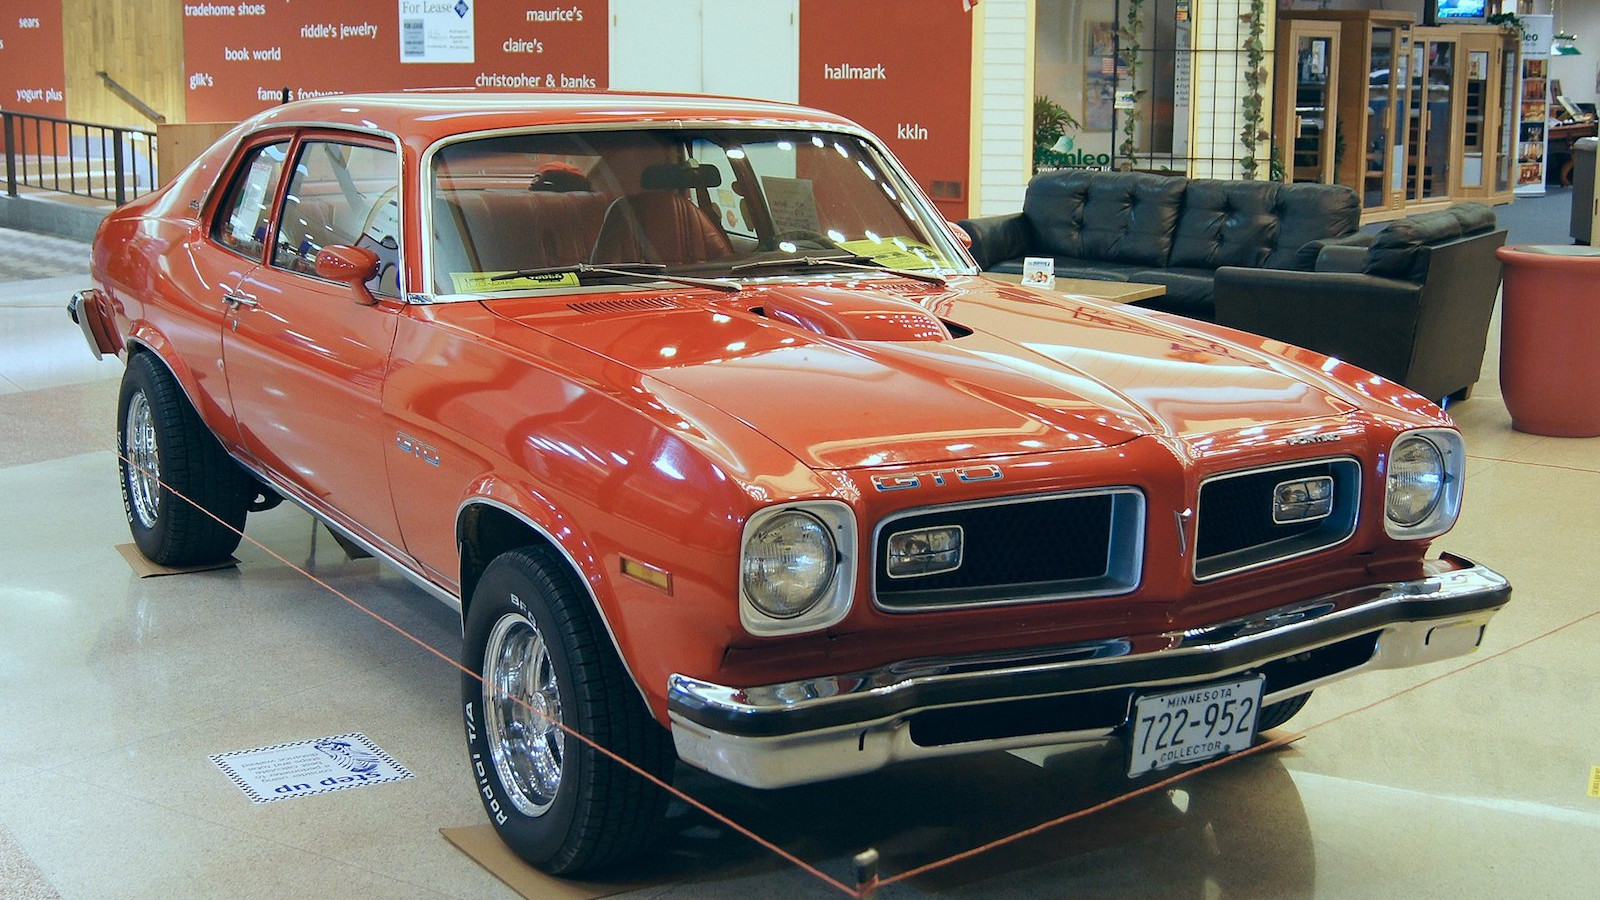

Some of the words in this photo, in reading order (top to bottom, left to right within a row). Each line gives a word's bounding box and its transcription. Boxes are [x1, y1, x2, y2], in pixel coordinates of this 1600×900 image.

[185, 2, 235, 17] tradehome
[237, 2, 266, 16] shoes
[402, 1, 421, 14] For
[423, 0, 453, 13] Lease
[526, 6, 583, 21] maurice's
[18, 17, 40, 28] sears
[300, 23, 337, 38] riddle's
[339, 21, 378, 40] jewelry
[502, 37, 543, 53] claire's
[224, 46, 250, 61] book
[252, 46, 281, 61] world
[824, 63, 886, 79] hallmark
[189, 72, 214, 90] glik's
[475, 72, 541, 87] christopher
[545, 73, 556, 88] &
[560, 73, 596, 88] banks
[16, 88, 43, 103] yogurt
[45, 87, 63, 103] plus
[257, 86, 294, 101] famos
[897, 123, 928, 140] kkln
[396, 430, 440, 467] GTO
[870, 464, 1004, 492] GTO
[1167, 688, 1232, 708] MINNESOTA
[466, 701, 477, 744] T/A
[1141, 697, 1253, 755] 722-952
[1160, 741, 1222, 763] COLLECTOR
[320, 772, 381, 786] step
[274, 783, 312, 794] up
[473, 753, 508, 826] Radial
